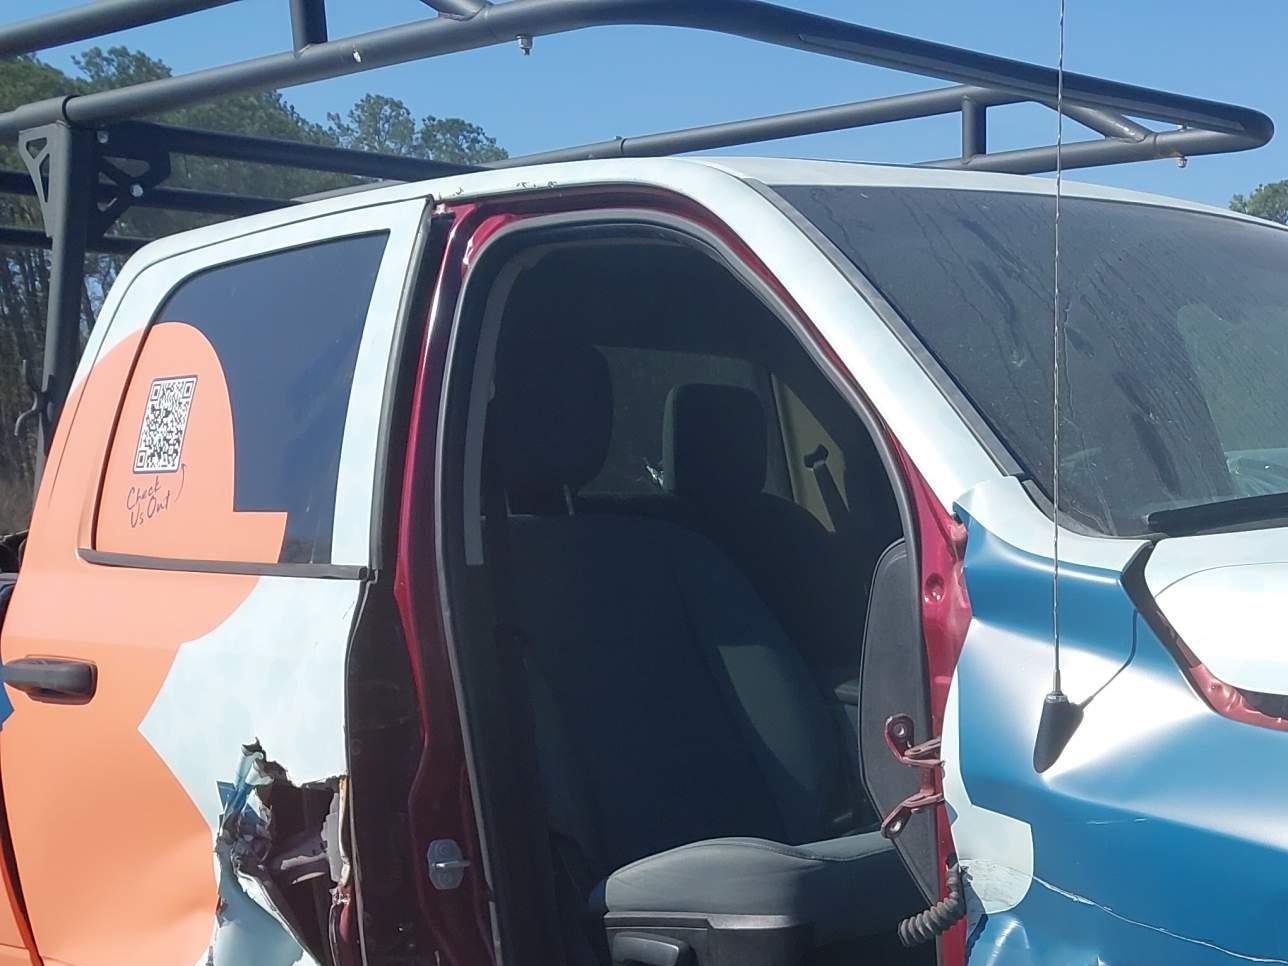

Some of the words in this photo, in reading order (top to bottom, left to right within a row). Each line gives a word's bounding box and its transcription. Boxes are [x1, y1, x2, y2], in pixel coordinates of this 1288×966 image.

[127, 476, 160, 510] Check
[130, 505, 144, 528] Us
[147, 490, 170, 519] Out
